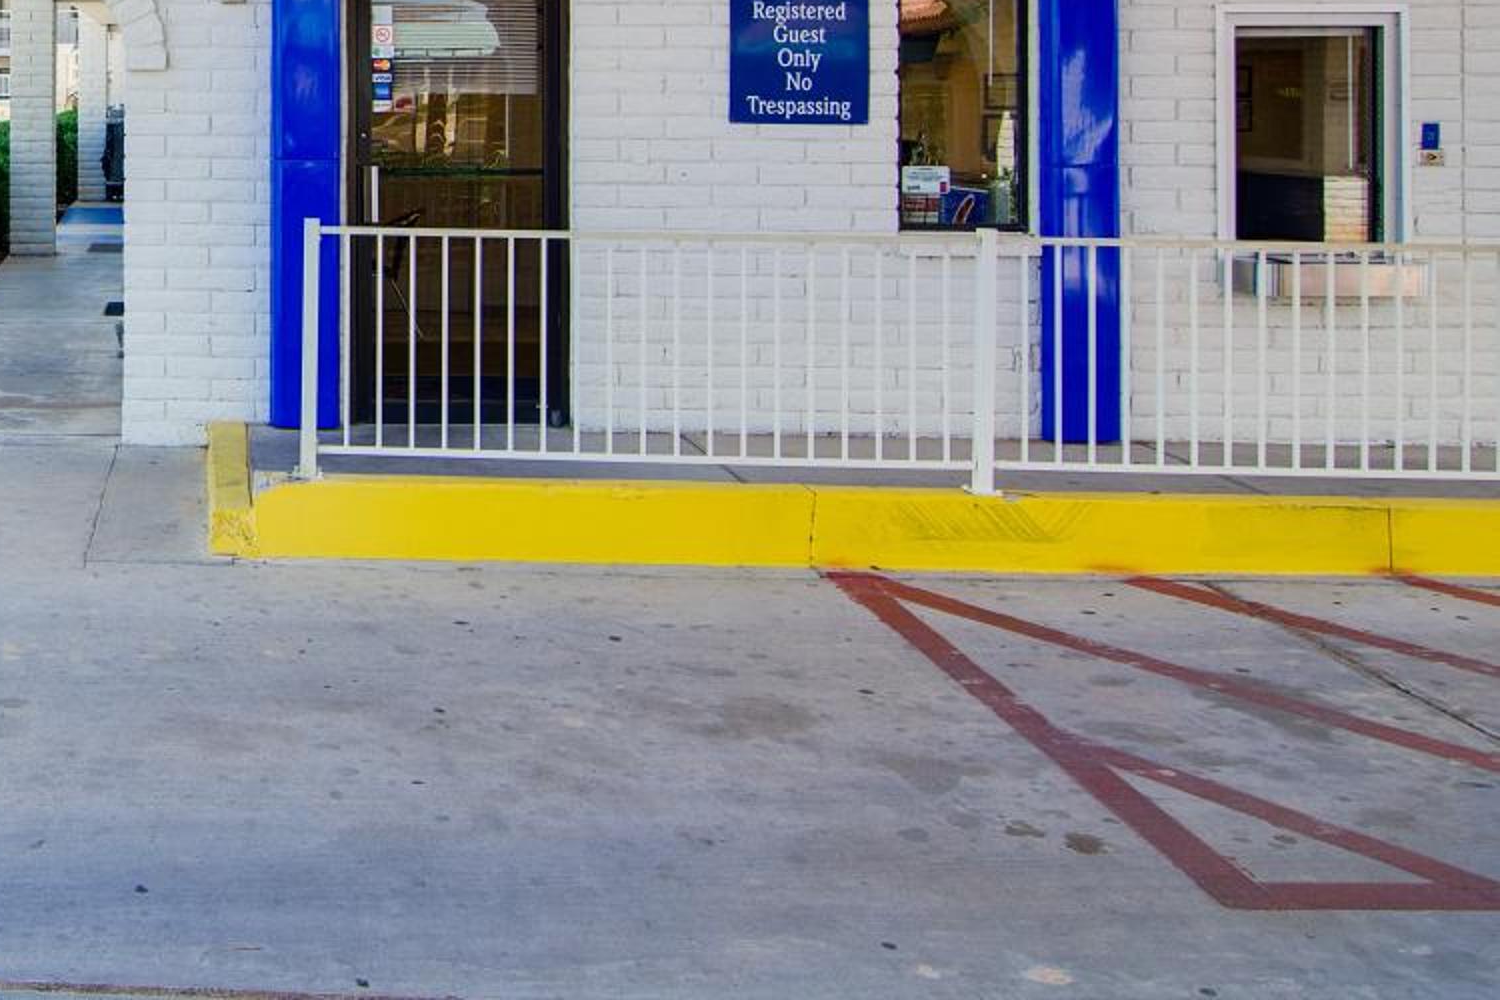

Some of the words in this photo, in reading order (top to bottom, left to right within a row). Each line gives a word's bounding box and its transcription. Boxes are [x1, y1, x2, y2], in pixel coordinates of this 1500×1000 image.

[752, 0, 846, 25] Registered
[773, 24, 826, 43] Guest
[777, 48, 821, 72] Only
[785, 71, 813, 91] No
[746, 95, 852, 120] Trespassing
